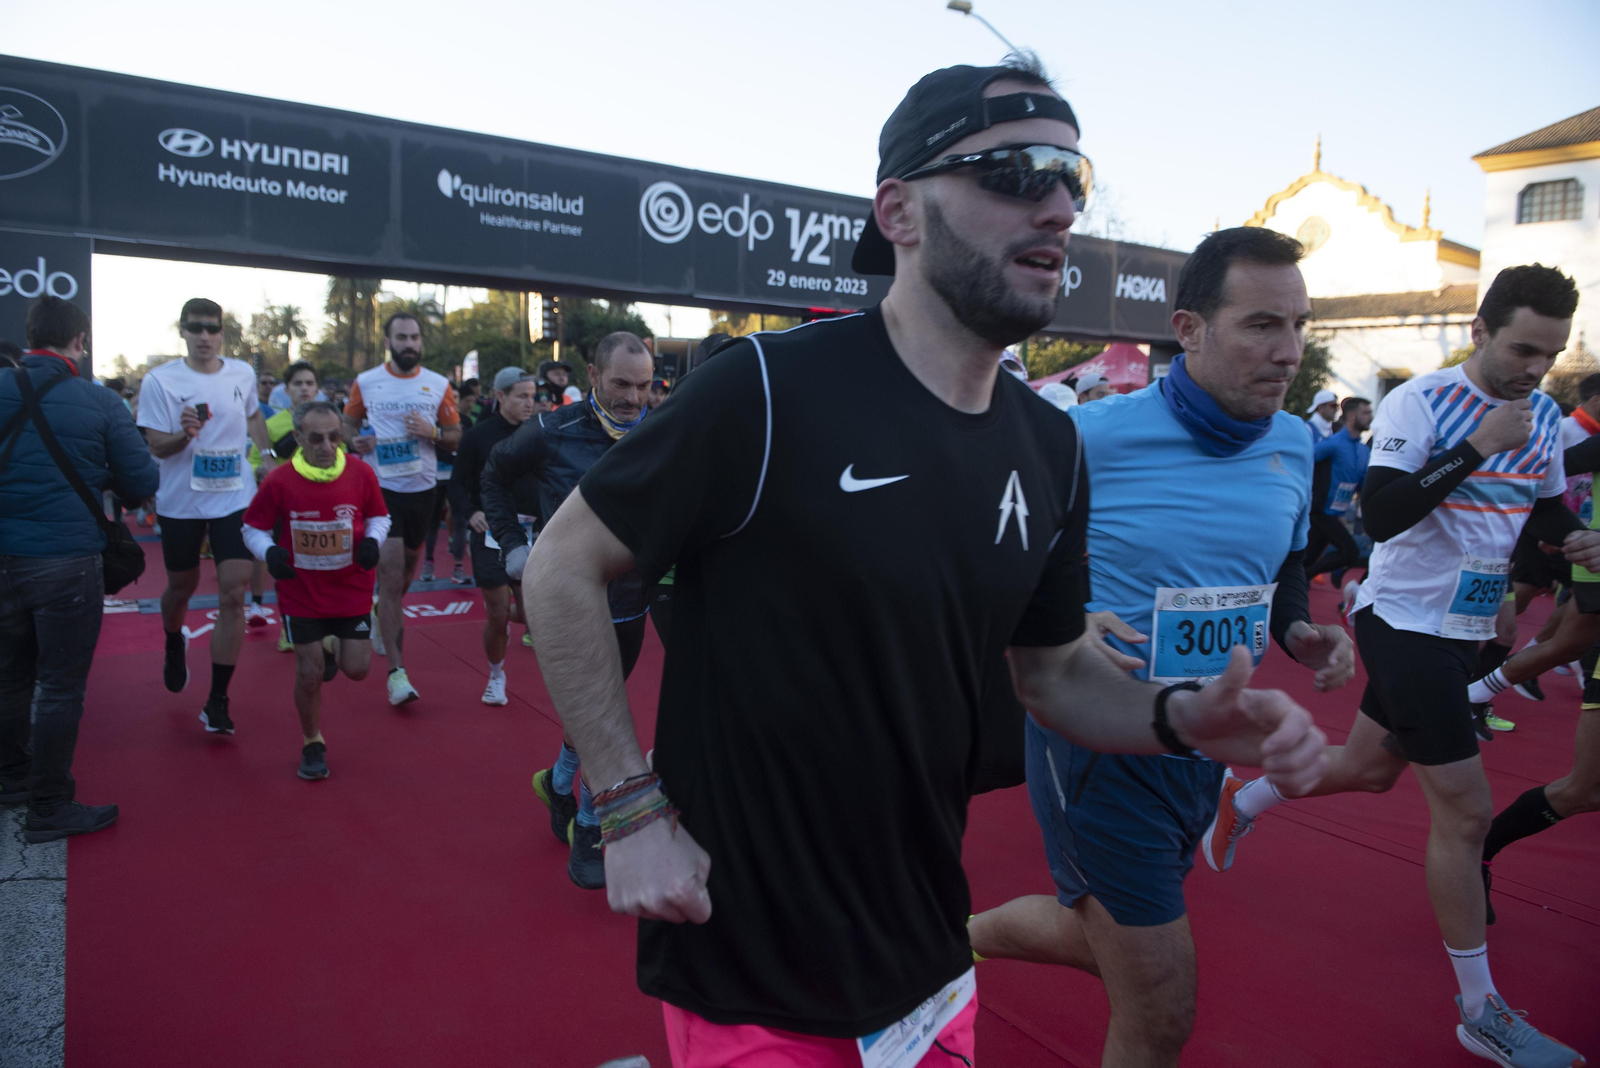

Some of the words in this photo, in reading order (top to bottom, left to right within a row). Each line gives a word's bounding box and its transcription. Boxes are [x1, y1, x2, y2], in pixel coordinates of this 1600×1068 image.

[220, 137, 350, 175] HYUNDAI
[158, 162, 283, 196] Hyundauto
[286, 179, 349, 204] Motor
[480, 210, 541, 232] Healthcare
[542, 218, 583, 237] Partner
[696, 192, 775, 252] edp
[766, 268, 786, 287] 29
[788, 275, 832, 292] enero
[834, 276, 869, 296] 2023
[1114, 272, 1166, 303] HOKA
[202, 457, 233, 473] 1537
[382, 443, 411, 460] 2194
[300, 532, 337, 549] 3701
[1174, 615, 1248, 657] 3003
